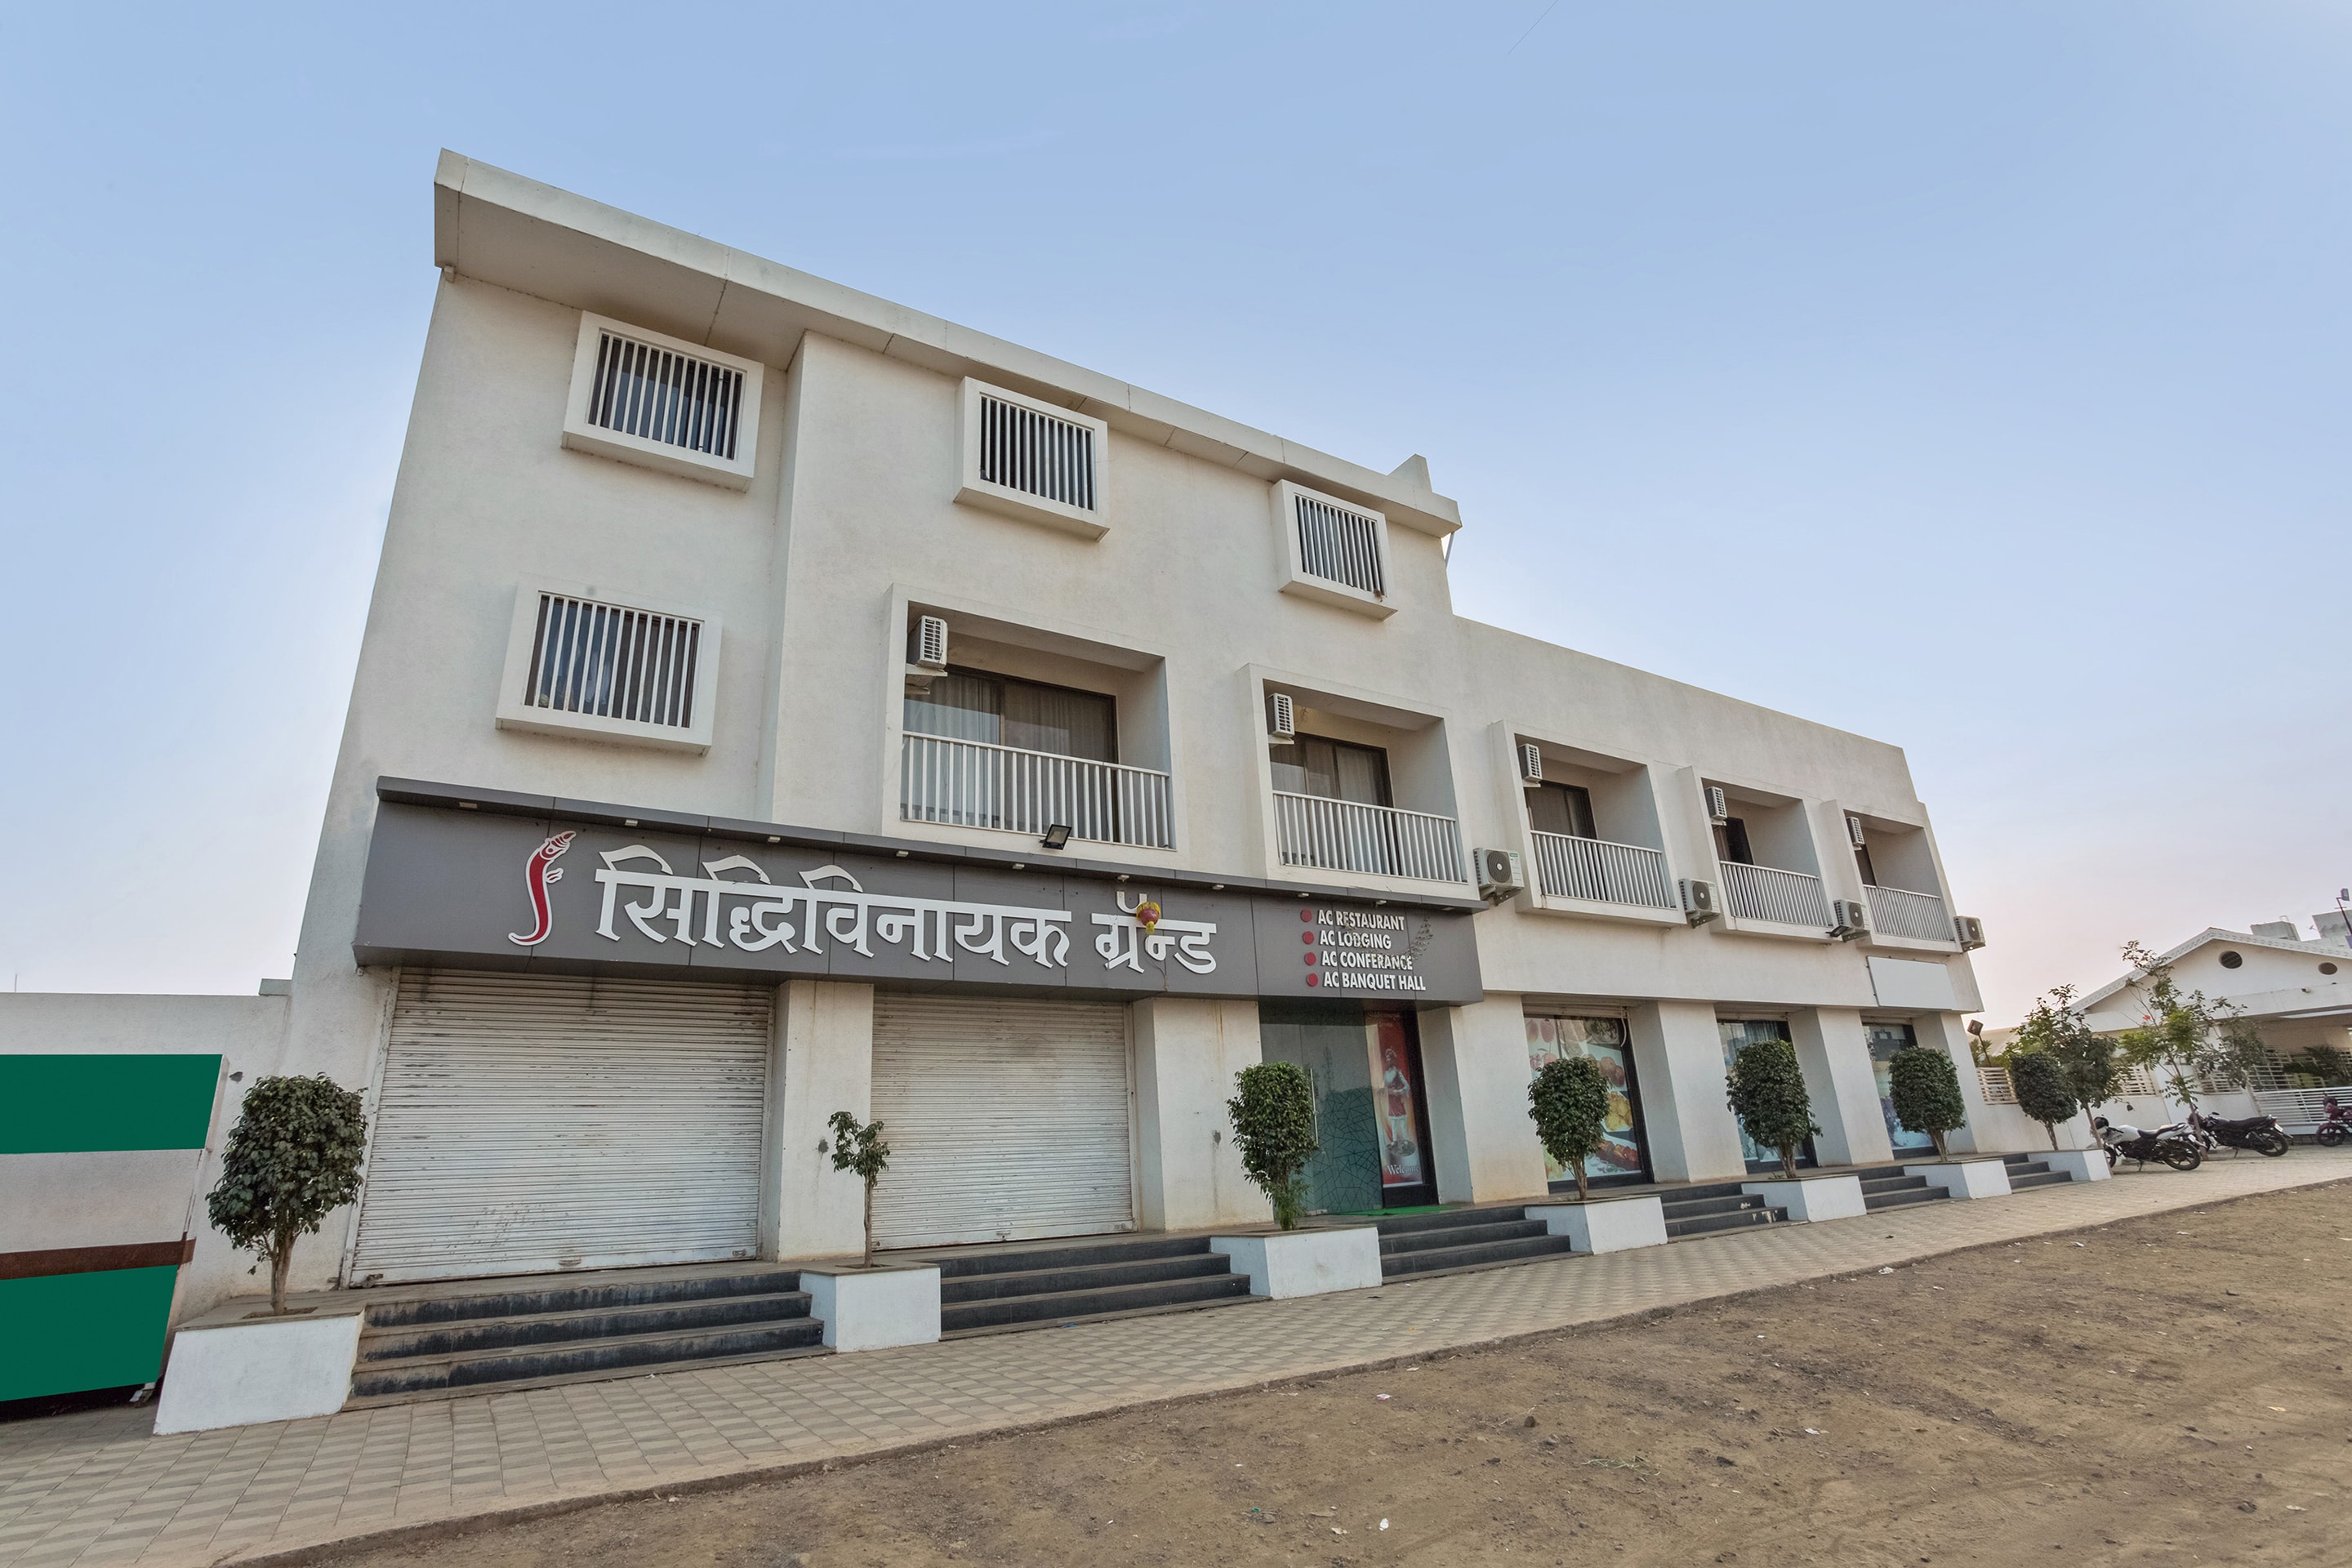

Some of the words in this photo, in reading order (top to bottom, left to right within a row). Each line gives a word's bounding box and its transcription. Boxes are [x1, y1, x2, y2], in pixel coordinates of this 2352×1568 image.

[595, 844, 1071, 969] सिद्धिविनायक
[1317, 909, 1334, 925] AC
[1335, 911, 1405, 931] RESTAURANT
[1320, 929, 1336, 946] AC
[1338, 931, 1392, 950] LODGING
[1321, 951, 1338, 967] AC
[1340, 951, 1413, 970] CONFERANCE
[1324, 971, 1340, 987] AC
[1342, 972, 1396, 991] BANQUET
[1398, 975, 1427, 991] HALL
